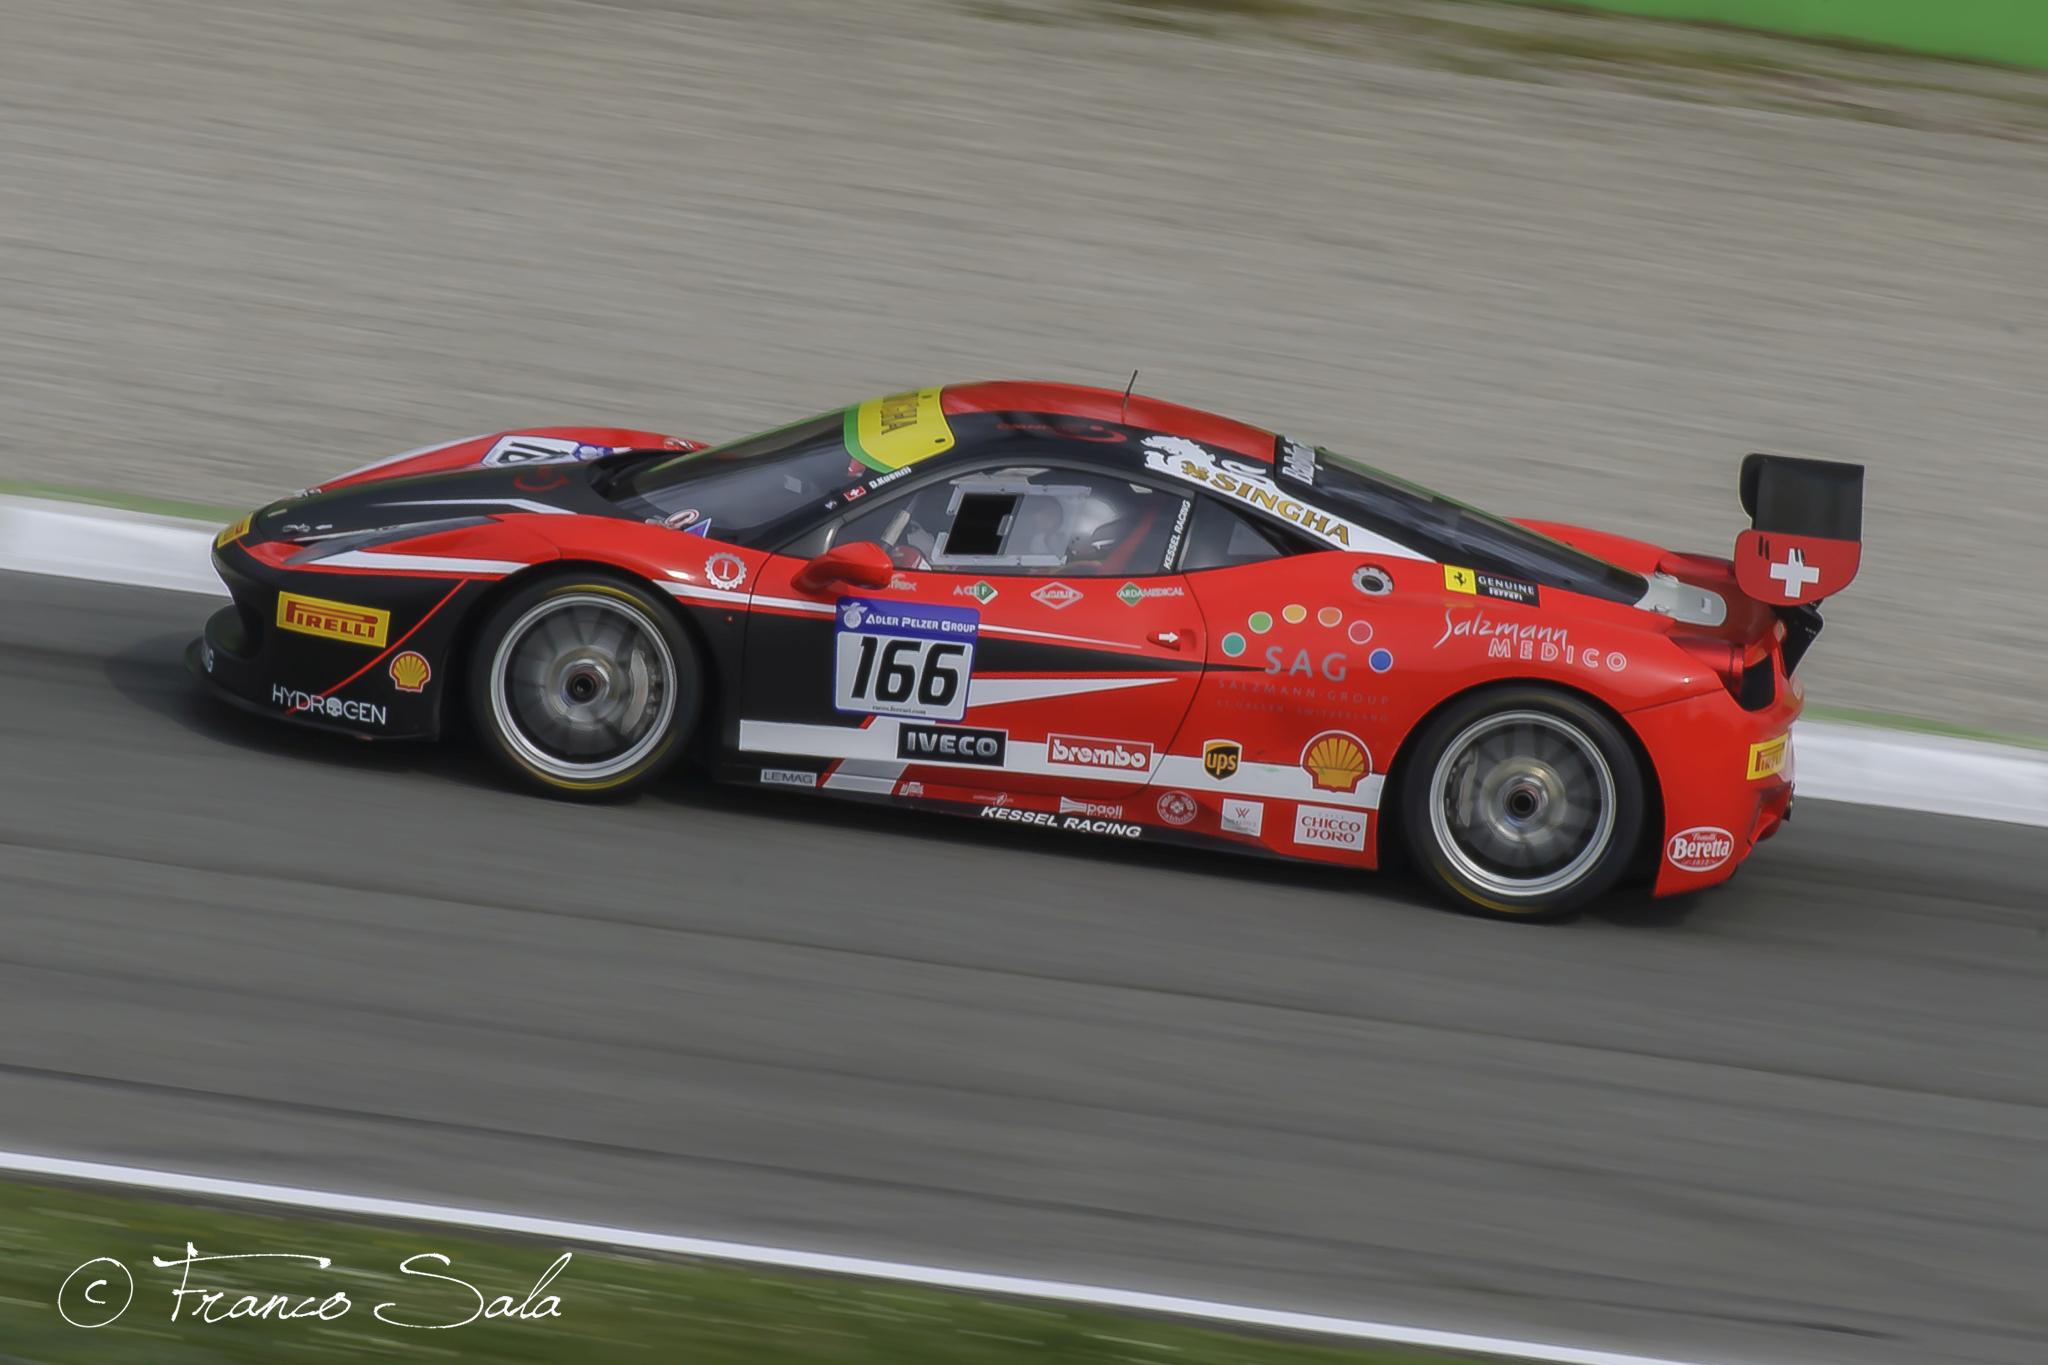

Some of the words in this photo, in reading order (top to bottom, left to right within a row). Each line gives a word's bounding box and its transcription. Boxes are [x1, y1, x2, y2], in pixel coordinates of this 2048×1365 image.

[1211, 472, 1350, 547] SINGHA
[1163, 534, 1181, 570] KESSEL
[1174, 499, 1191, 535] RACING
[1478, 575, 1535, 596] GENUINE
[285, 600, 379, 639] PIRELLI
[865, 613, 899, 627] ADLER
[901, 616, 939, 630] PELZER
[941, 620, 976, 633] GROUP
[1433, 607, 1568, 651] Salzmann
[850, 635, 966, 707] 166
[1264, 645, 1347, 682] SAG
[1488, 638, 1627, 673] MEDICO
[906, 731, 999, 758] IVECO
[1052, 738, 1147, 769] brembo
[1207, 752, 1237, 776] ups
[980, 805, 1058, 828] KESSEL
[1063, 817, 1142, 839] RACING
[1301, 815, 1361, 833] CHICCO
[1305, 828, 1356, 844] D'ORO
[1672, 837, 1730, 860] Beretta
